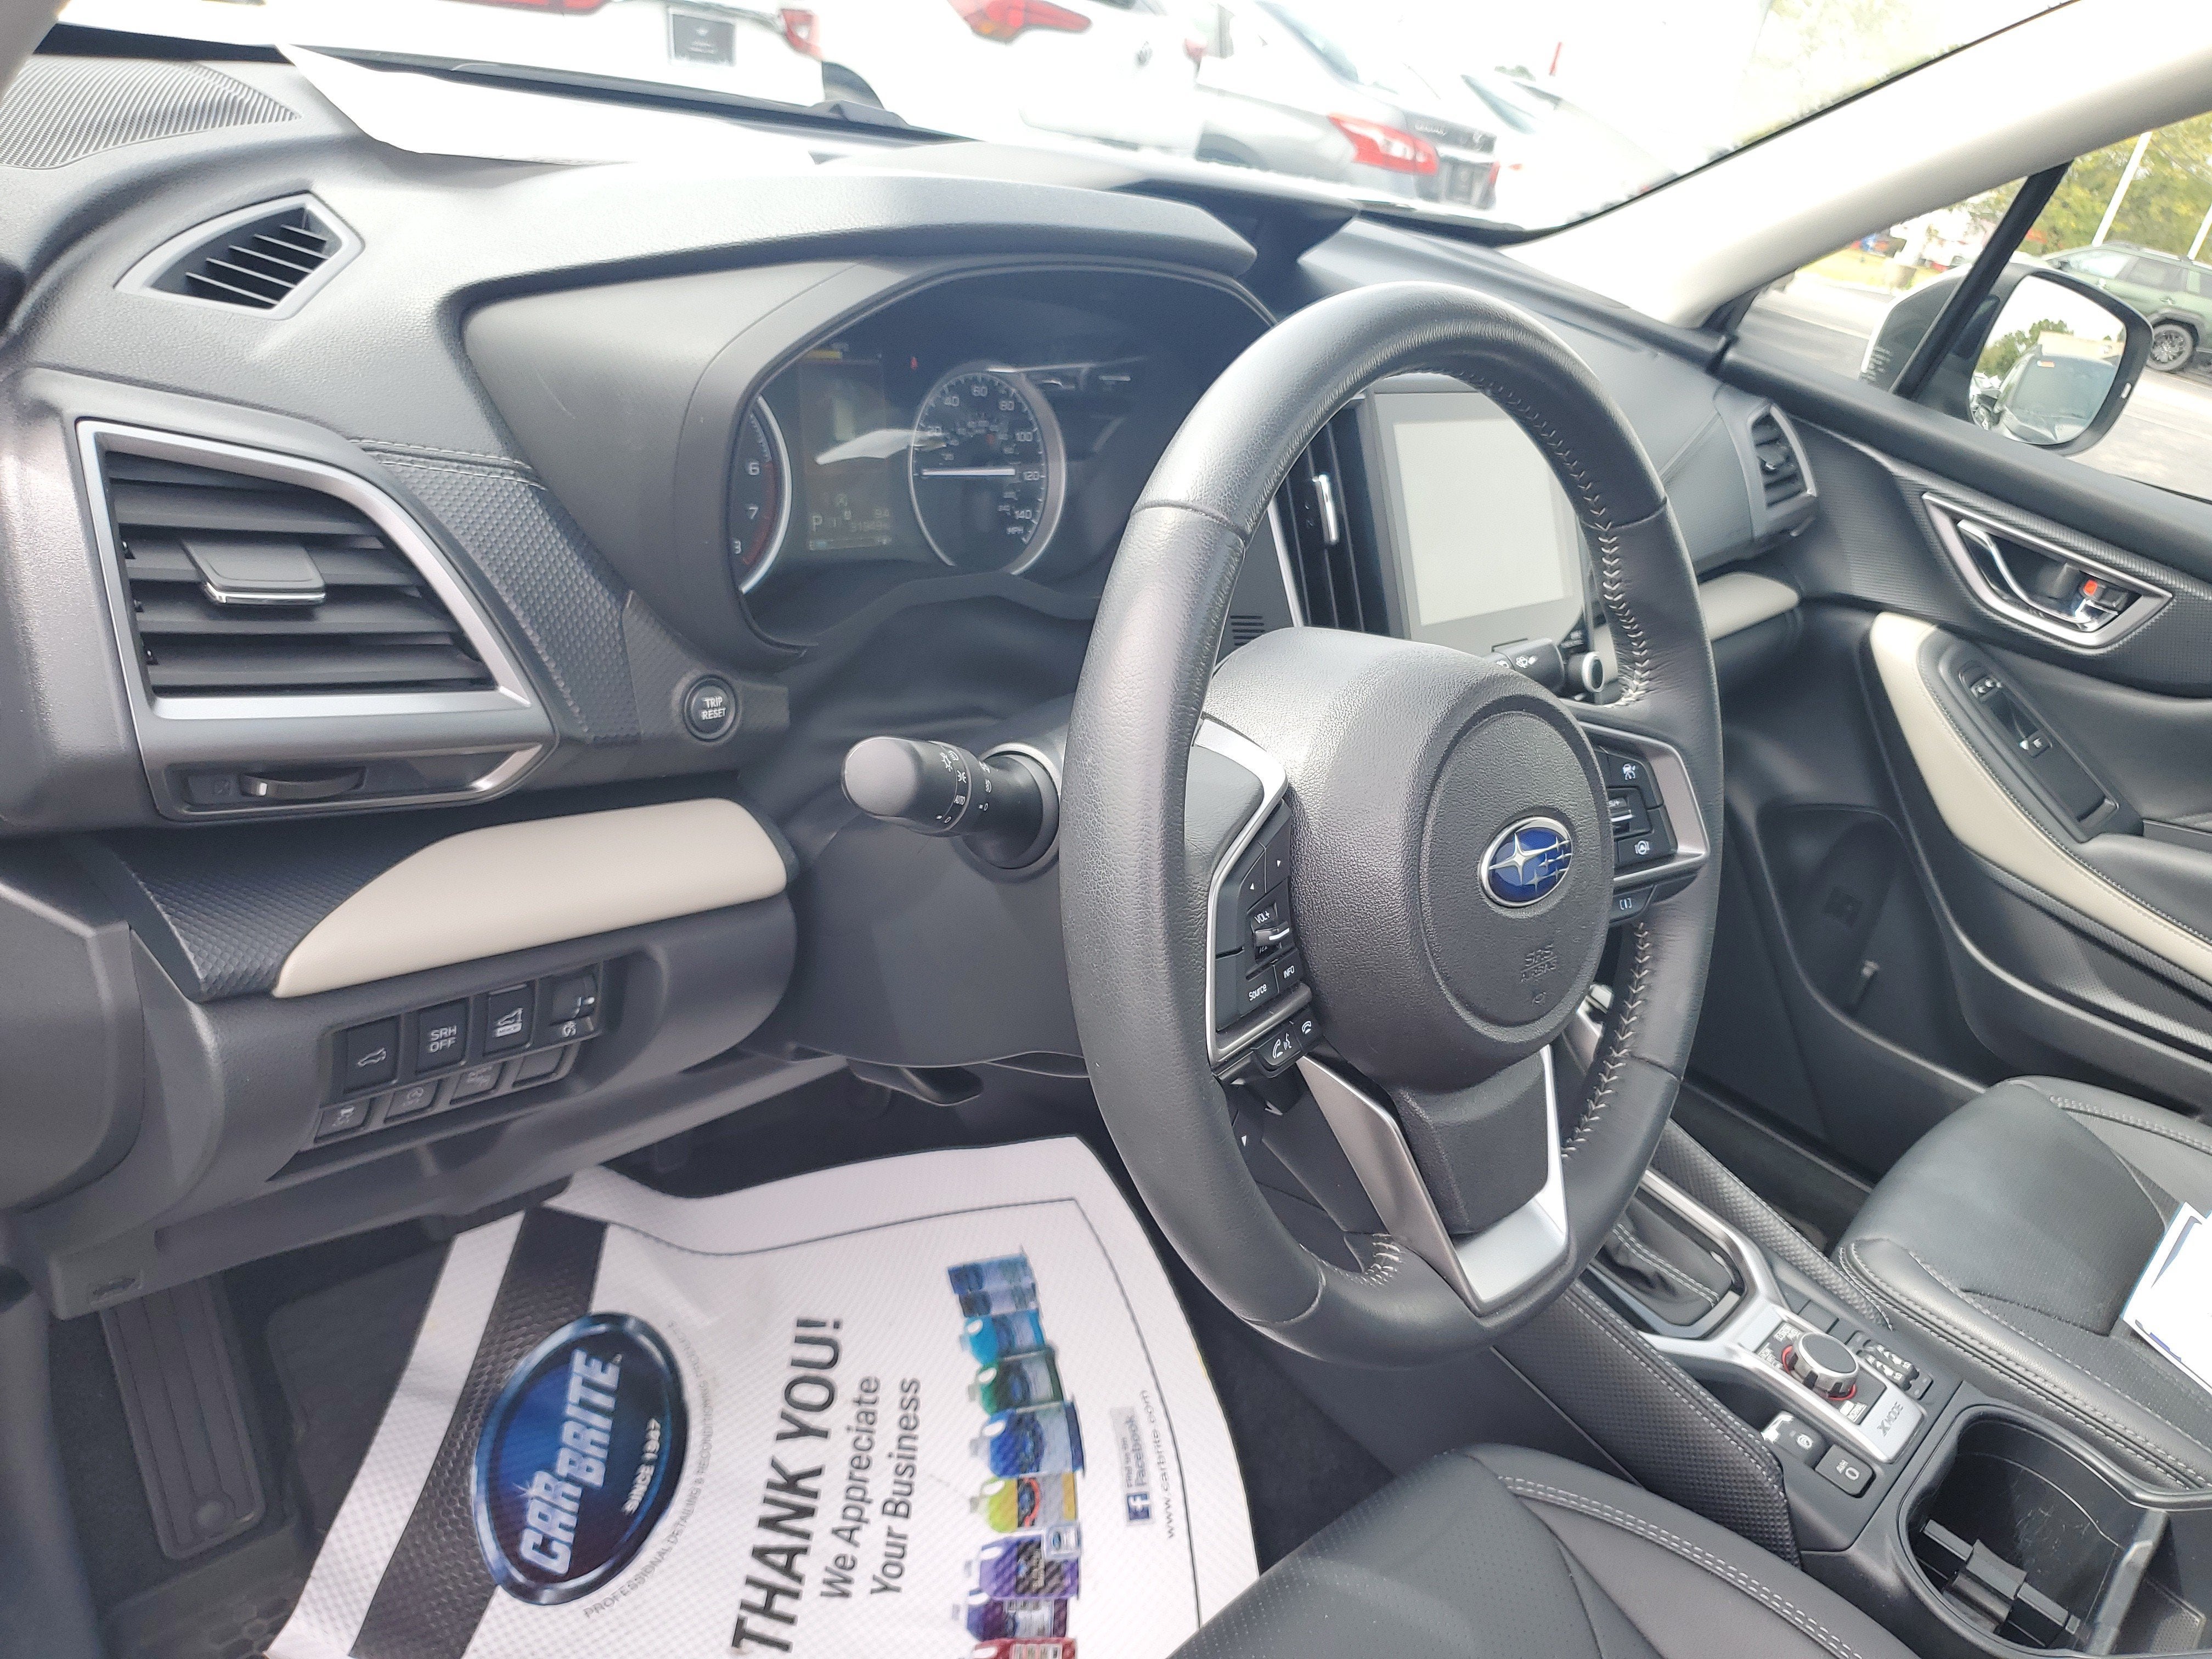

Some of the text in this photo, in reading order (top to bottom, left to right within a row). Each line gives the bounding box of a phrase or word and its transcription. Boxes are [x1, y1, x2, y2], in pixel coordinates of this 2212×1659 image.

[749, 461, 760, 476] 6
[748, 506, 759, 520] 7
[703, 696, 723, 708] TRIP
[701, 708, 726, 720] RESET
[955, 794, 966, 805] AUTO
[1283, 965, 1295, 979] INFO
[430, 1025, 456, 1042] SRH
[430, 1037, 456, 1053] OFF
[621, 1463, 656, 1516] SINCE
[731, 1318, 841, 1653] THANK YOU!
[820, 1375, 880, 1598] We Appreciate
[870, 1376, 921, 1594] Your Business
[583, 1547, 673, 1618] PROFESSIONAL
